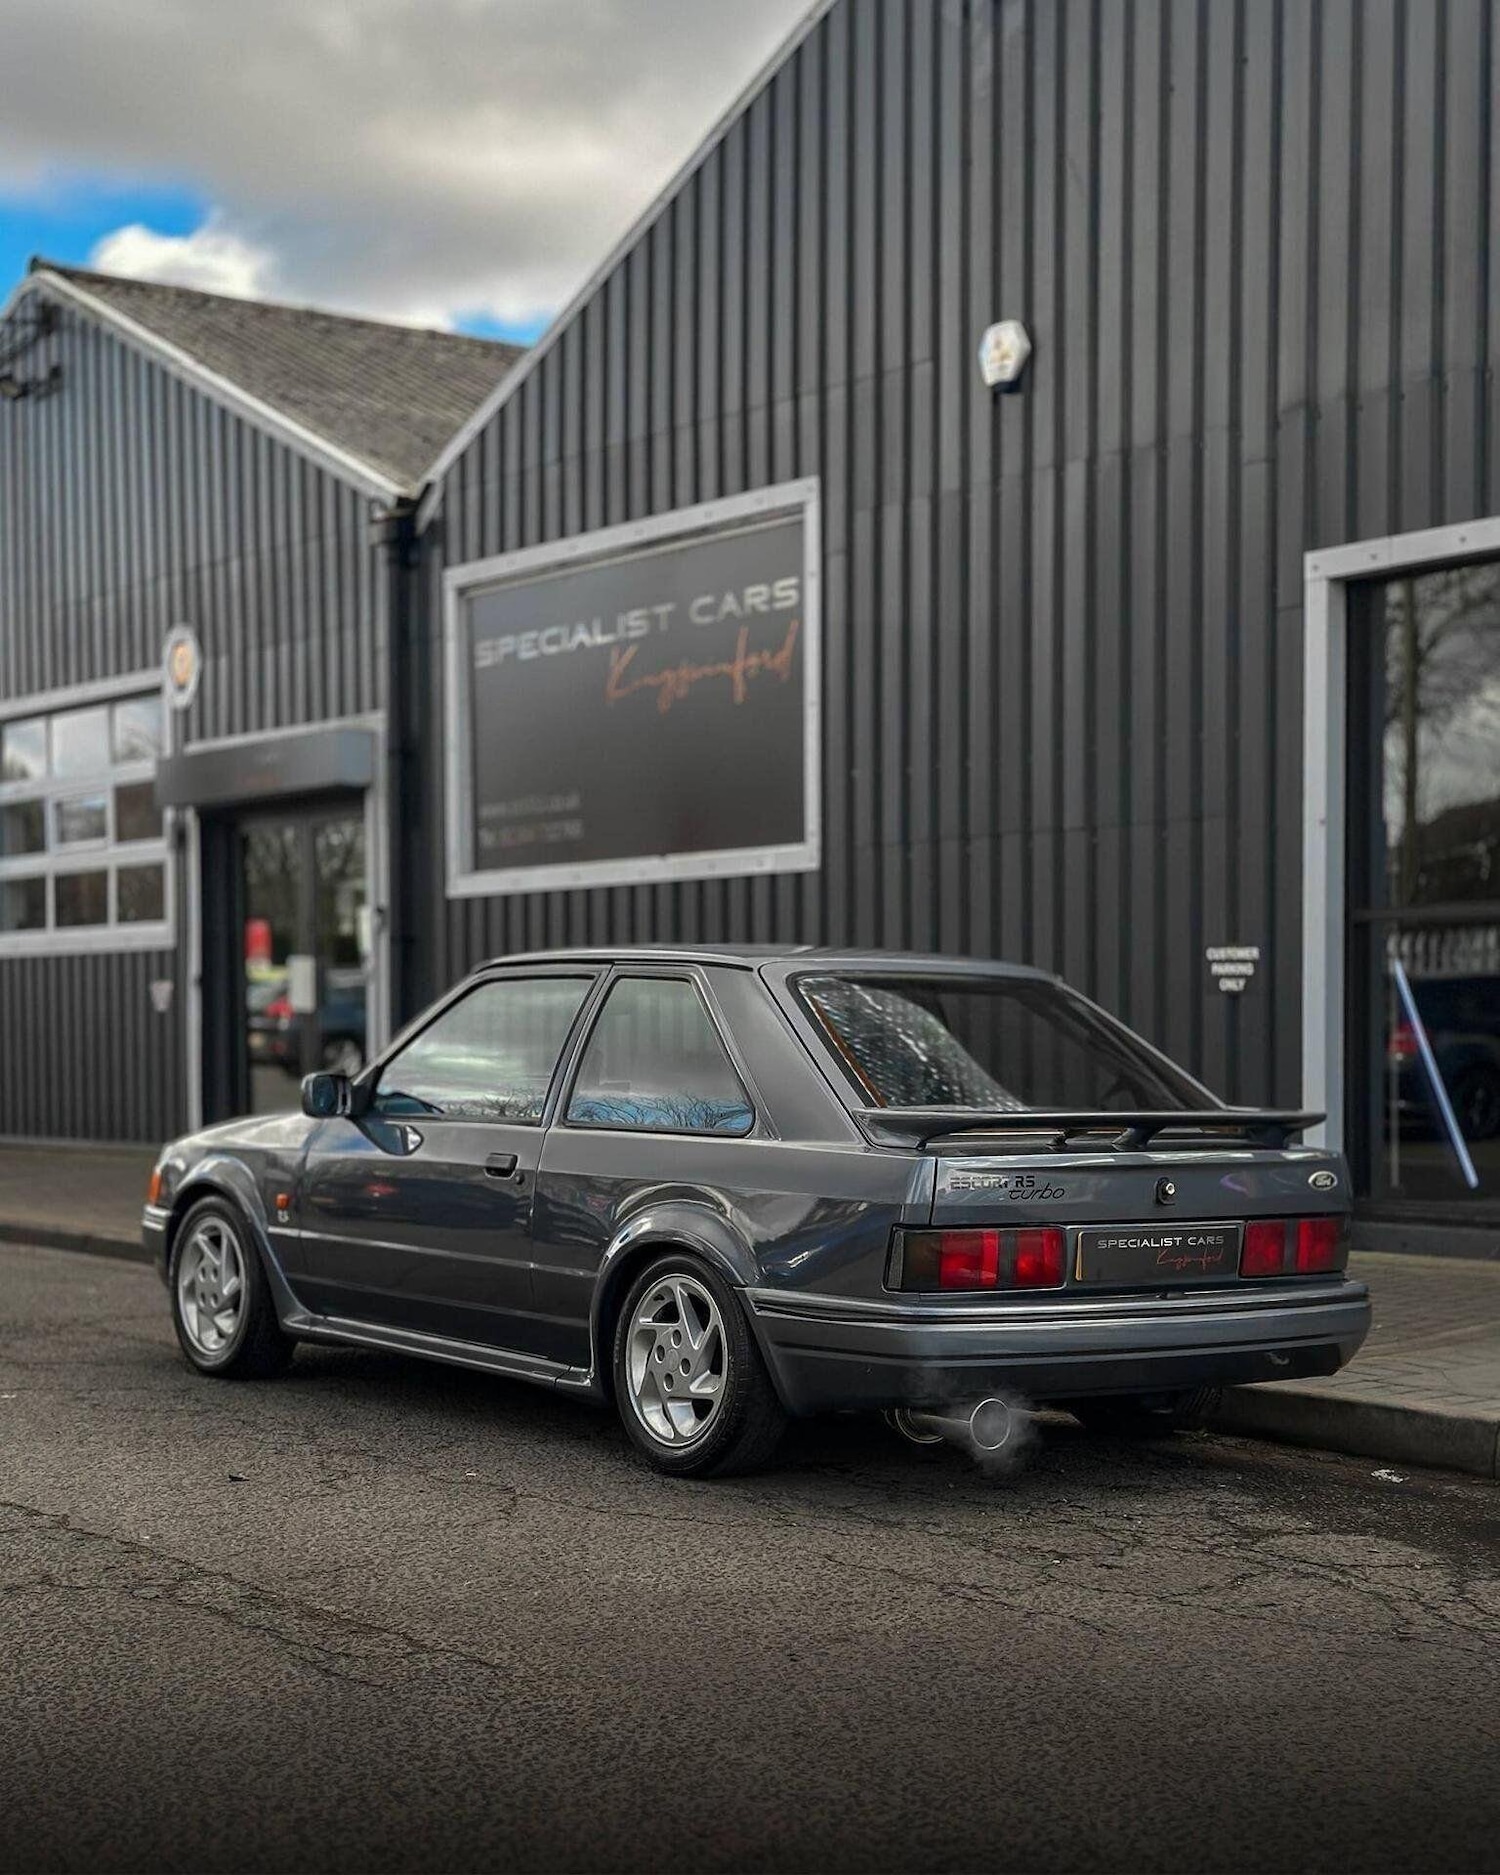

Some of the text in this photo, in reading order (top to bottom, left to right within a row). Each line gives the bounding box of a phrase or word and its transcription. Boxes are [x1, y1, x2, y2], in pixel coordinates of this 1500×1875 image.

[475, 576, 800, 668] SPECIALIST CARS
[950, 1175, 1035, 1190] ESCORT RS
[1009, 1182, 1065, 1200] turbo
[1097, 1235, 1224, 1249] SPECIALIST CARS
